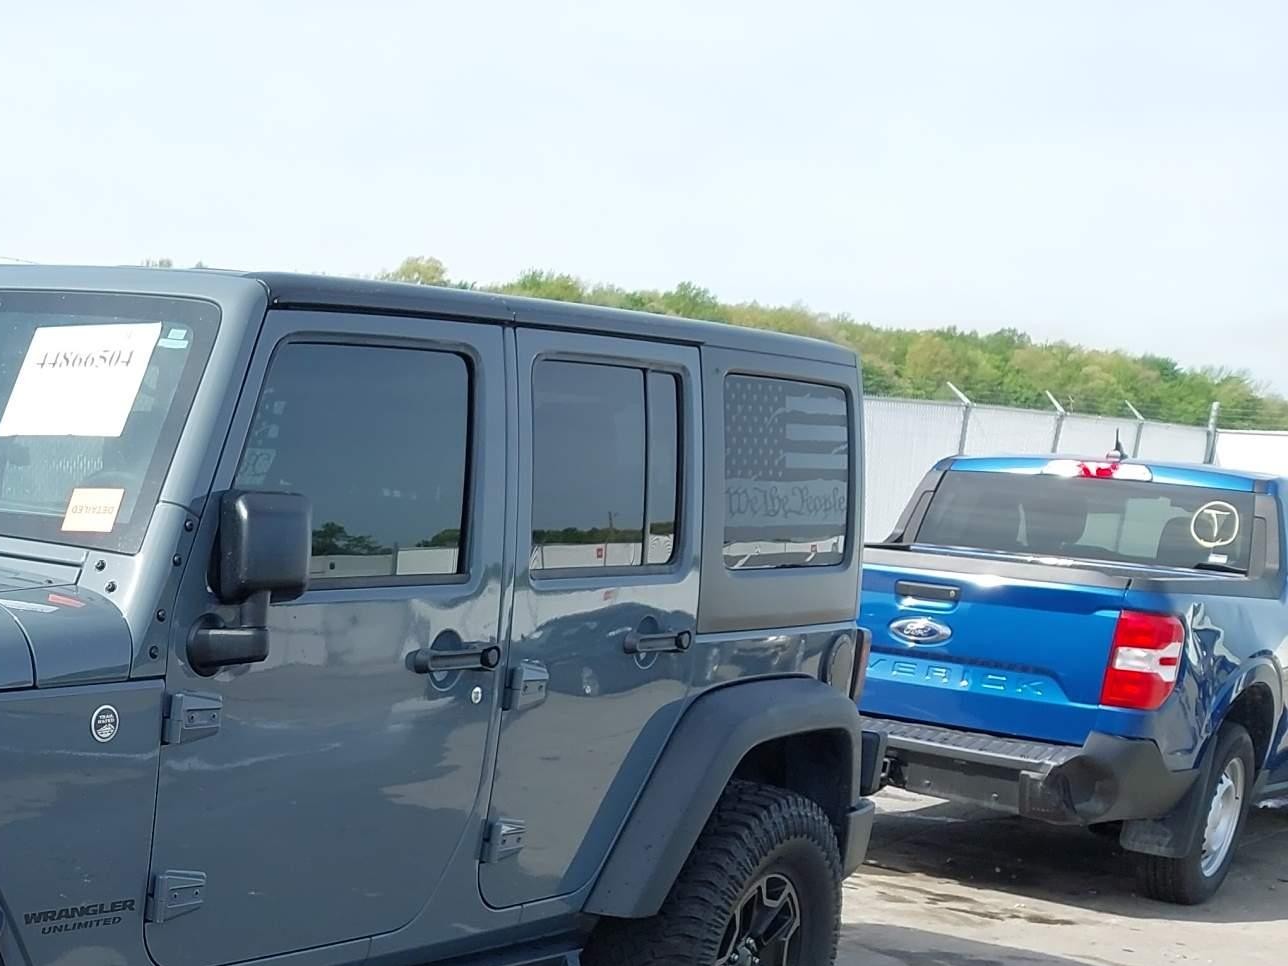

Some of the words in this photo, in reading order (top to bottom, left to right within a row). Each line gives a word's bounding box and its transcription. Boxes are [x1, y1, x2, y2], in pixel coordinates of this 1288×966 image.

[35, 349, 135, 369] 44866504
[725, 485, 759, 519] We
[753, 485, 789, 519] The
[785, 485, 846, 520] People
[1203, 508, 1231, 537] T
[24, 899, 135, 925] WRANGLER
[41, 916, 122, 935] UNLIMITED
